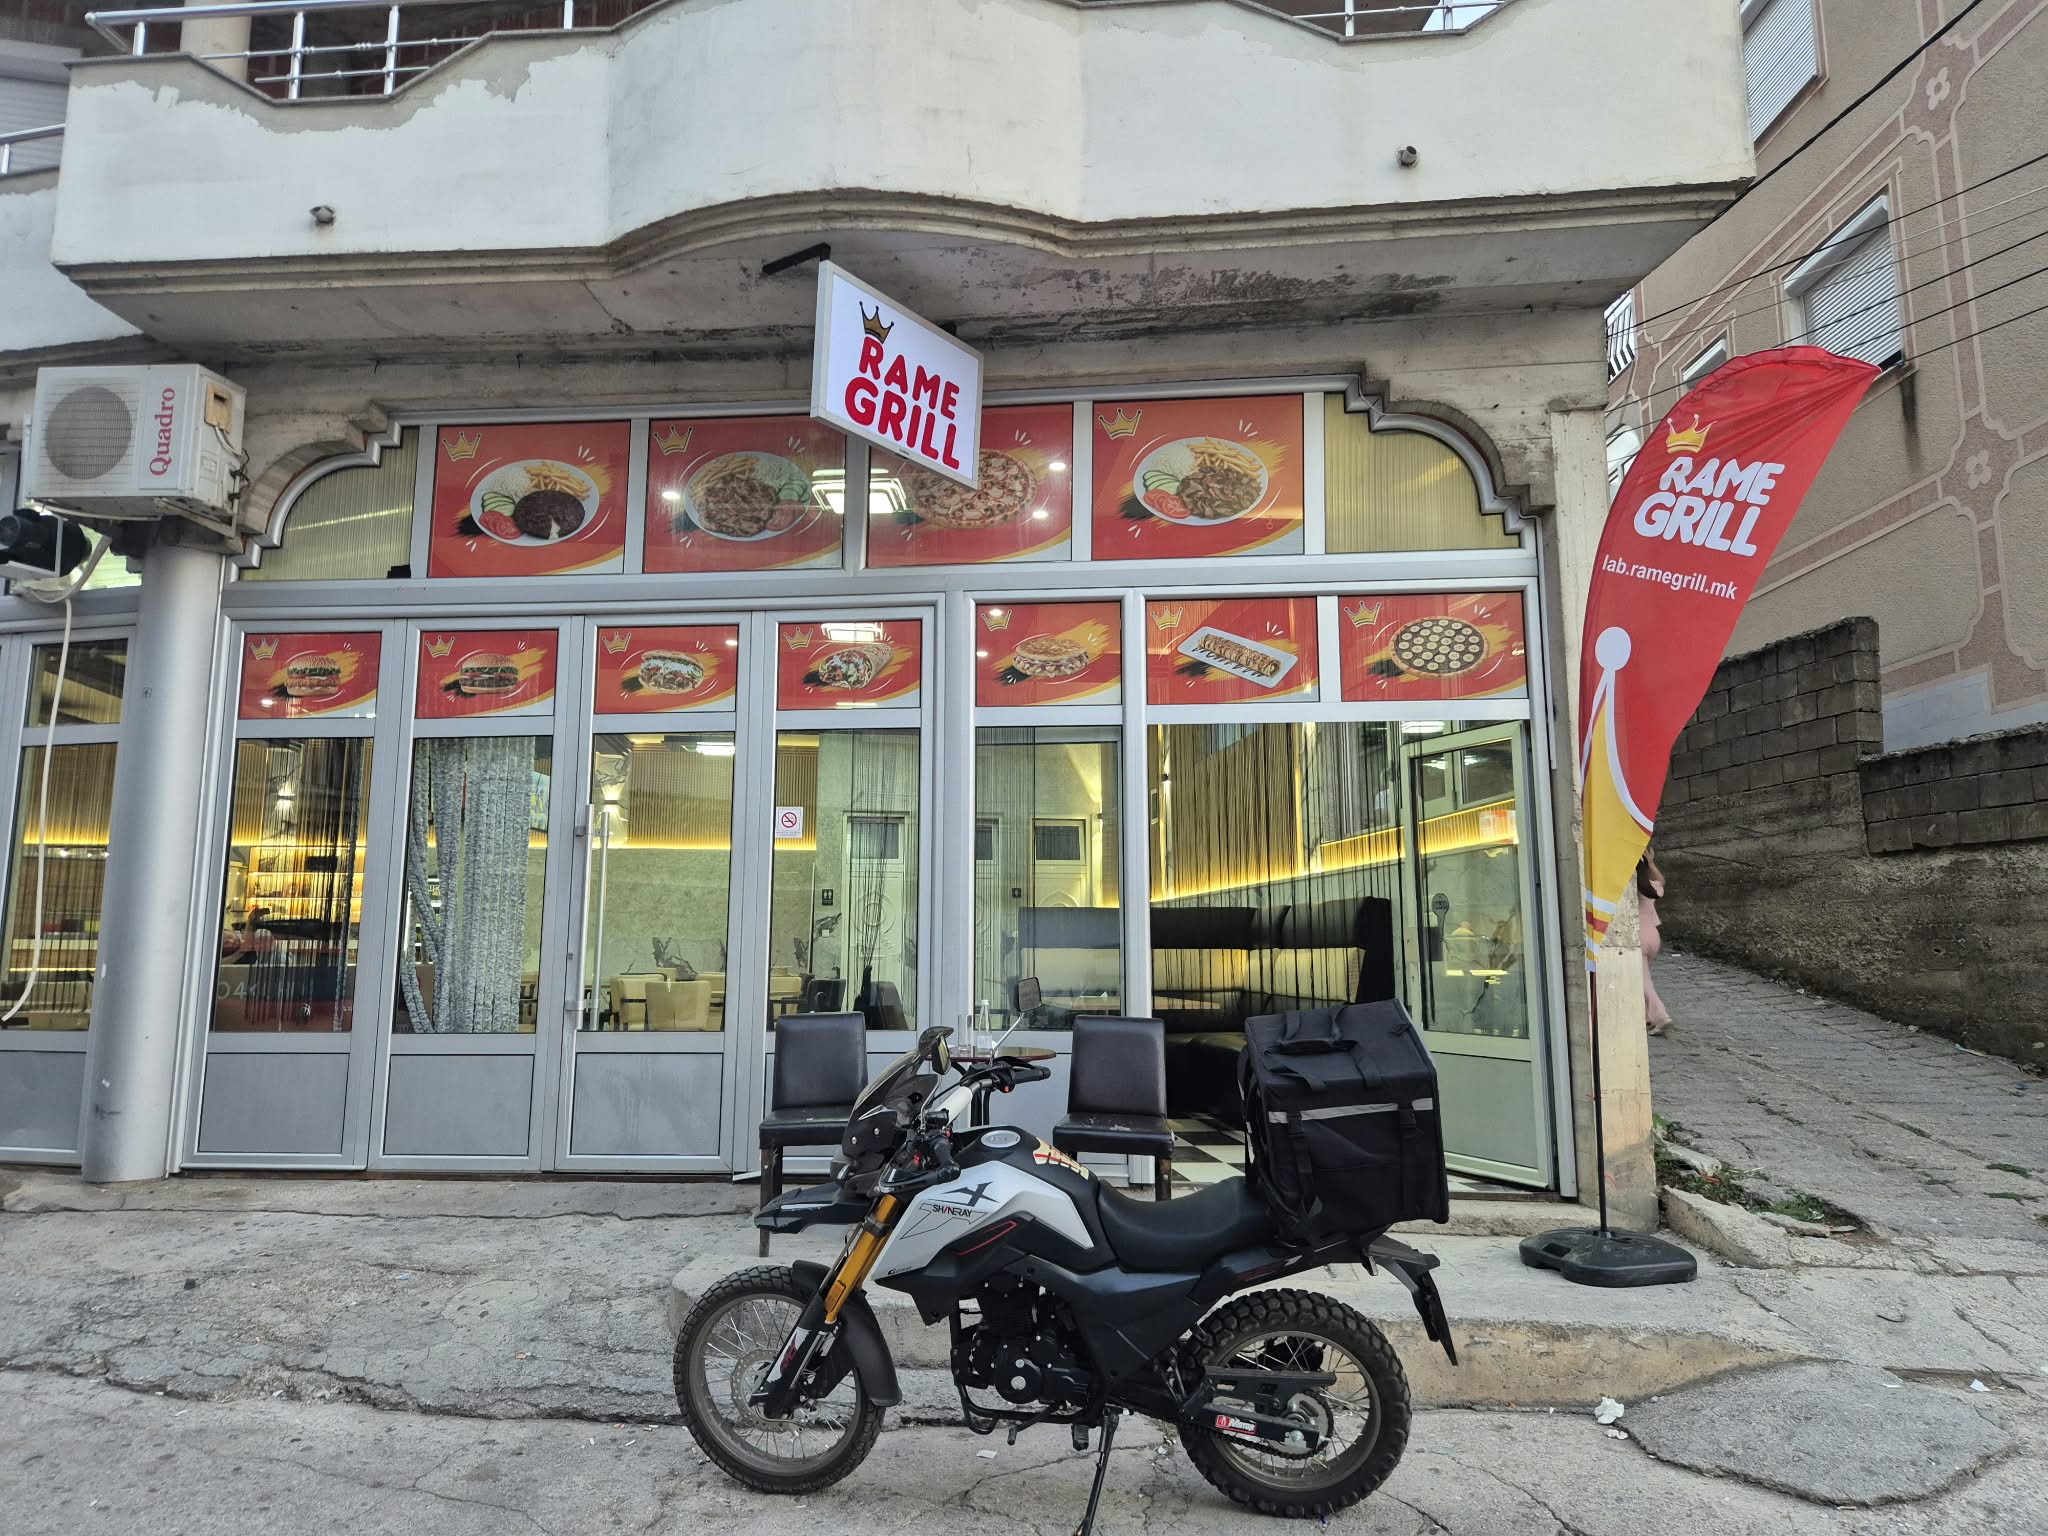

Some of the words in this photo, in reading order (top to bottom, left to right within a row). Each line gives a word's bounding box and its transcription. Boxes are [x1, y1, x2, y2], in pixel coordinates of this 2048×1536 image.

[858, 336, 960, 420] RAME
[149, 387, 176, 476] Quadro
[844, 376, 960, 470] GRILL
[1659, 456, 1785, 505] RAME
[1633, 491, 1761, 557] GRILL
[1601, 554, 1738, 600] lab.ramegrill.mk
[932, 1204, 973, 1218] SHINERAY
